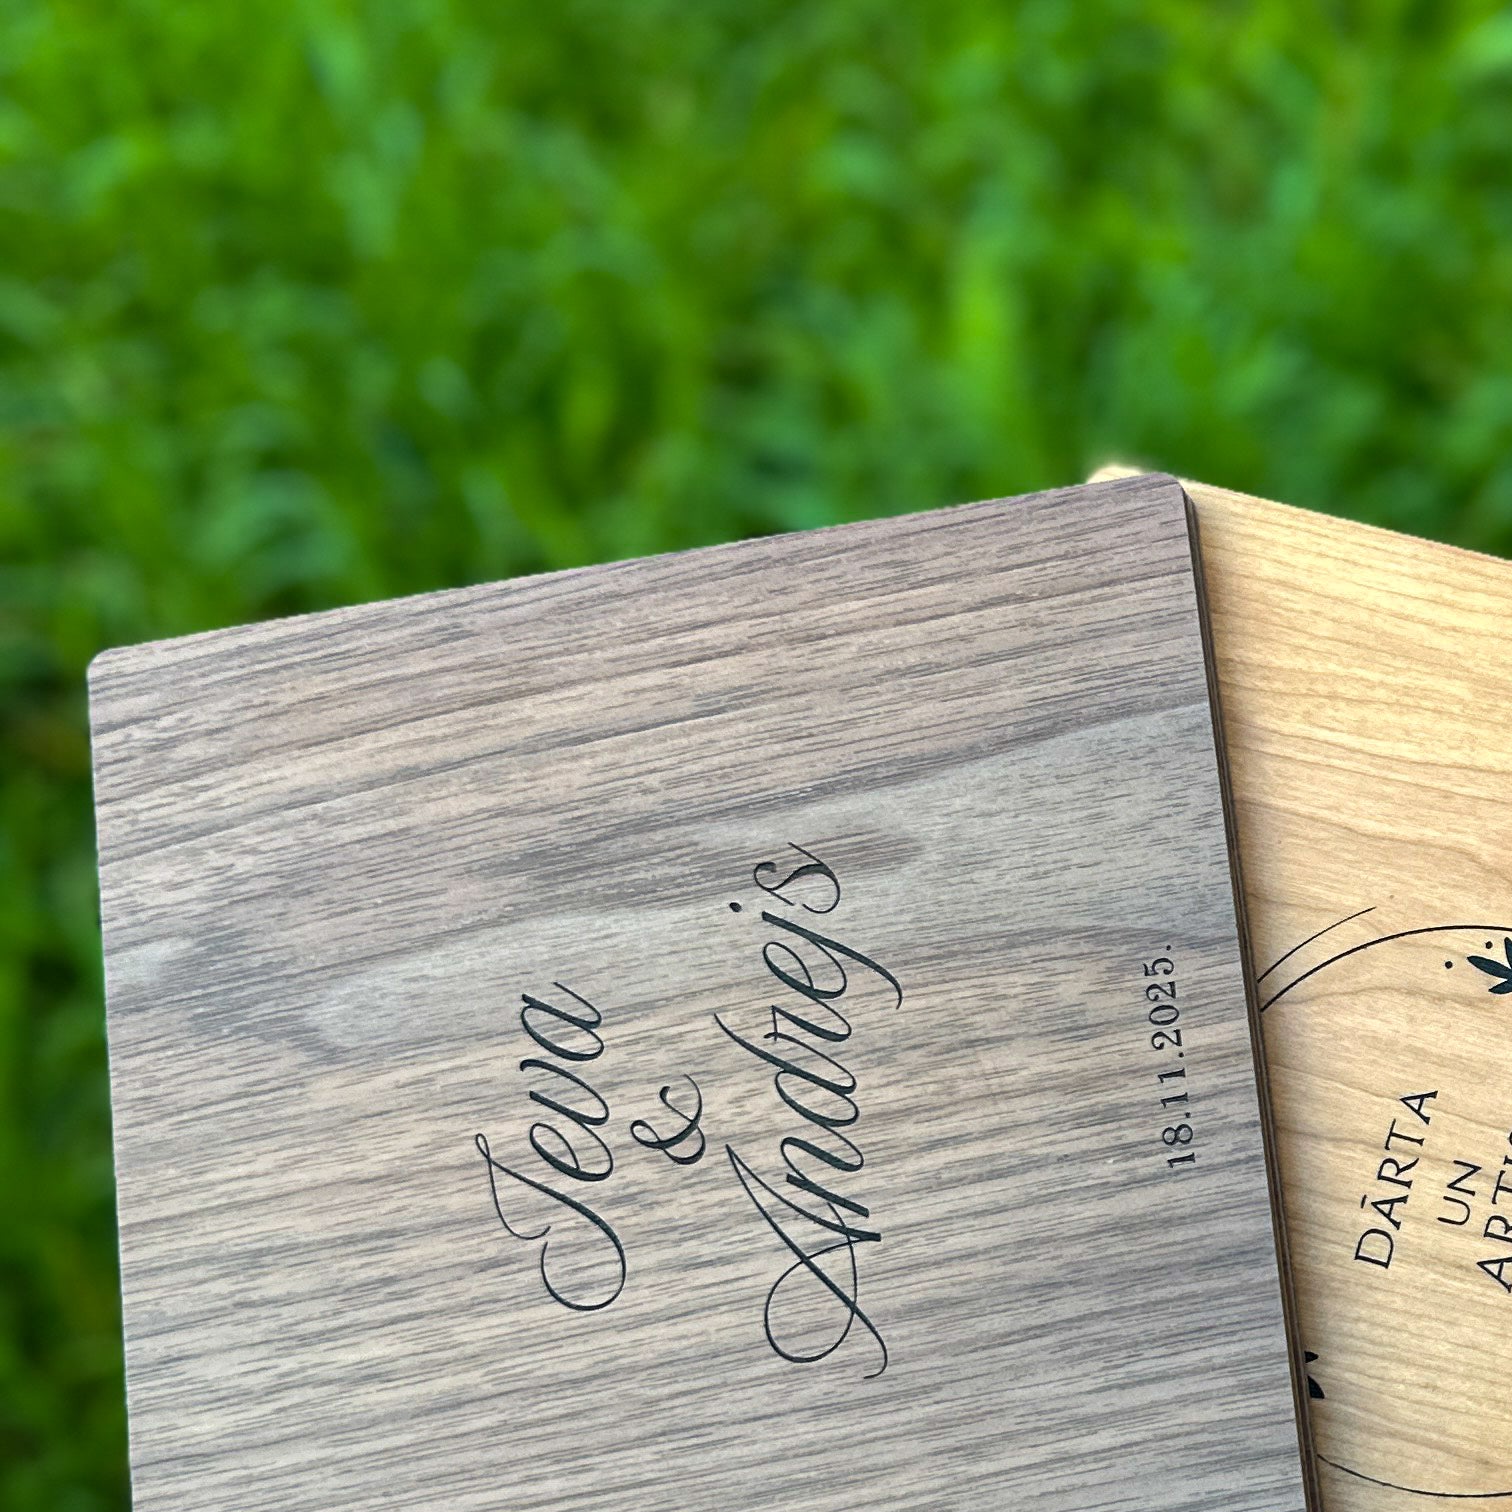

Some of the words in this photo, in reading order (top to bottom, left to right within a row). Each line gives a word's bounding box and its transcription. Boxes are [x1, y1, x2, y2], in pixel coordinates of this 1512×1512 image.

[630, 1074, 706, 1165] &
[714, 842, 903, 1379] Andrejs
[1143, 944, 1196, 1169] 18.11.2025.
[1354, 1091, 1438, 1269] DĀRTA
[1437, 1160, 1482, 1226] UN
